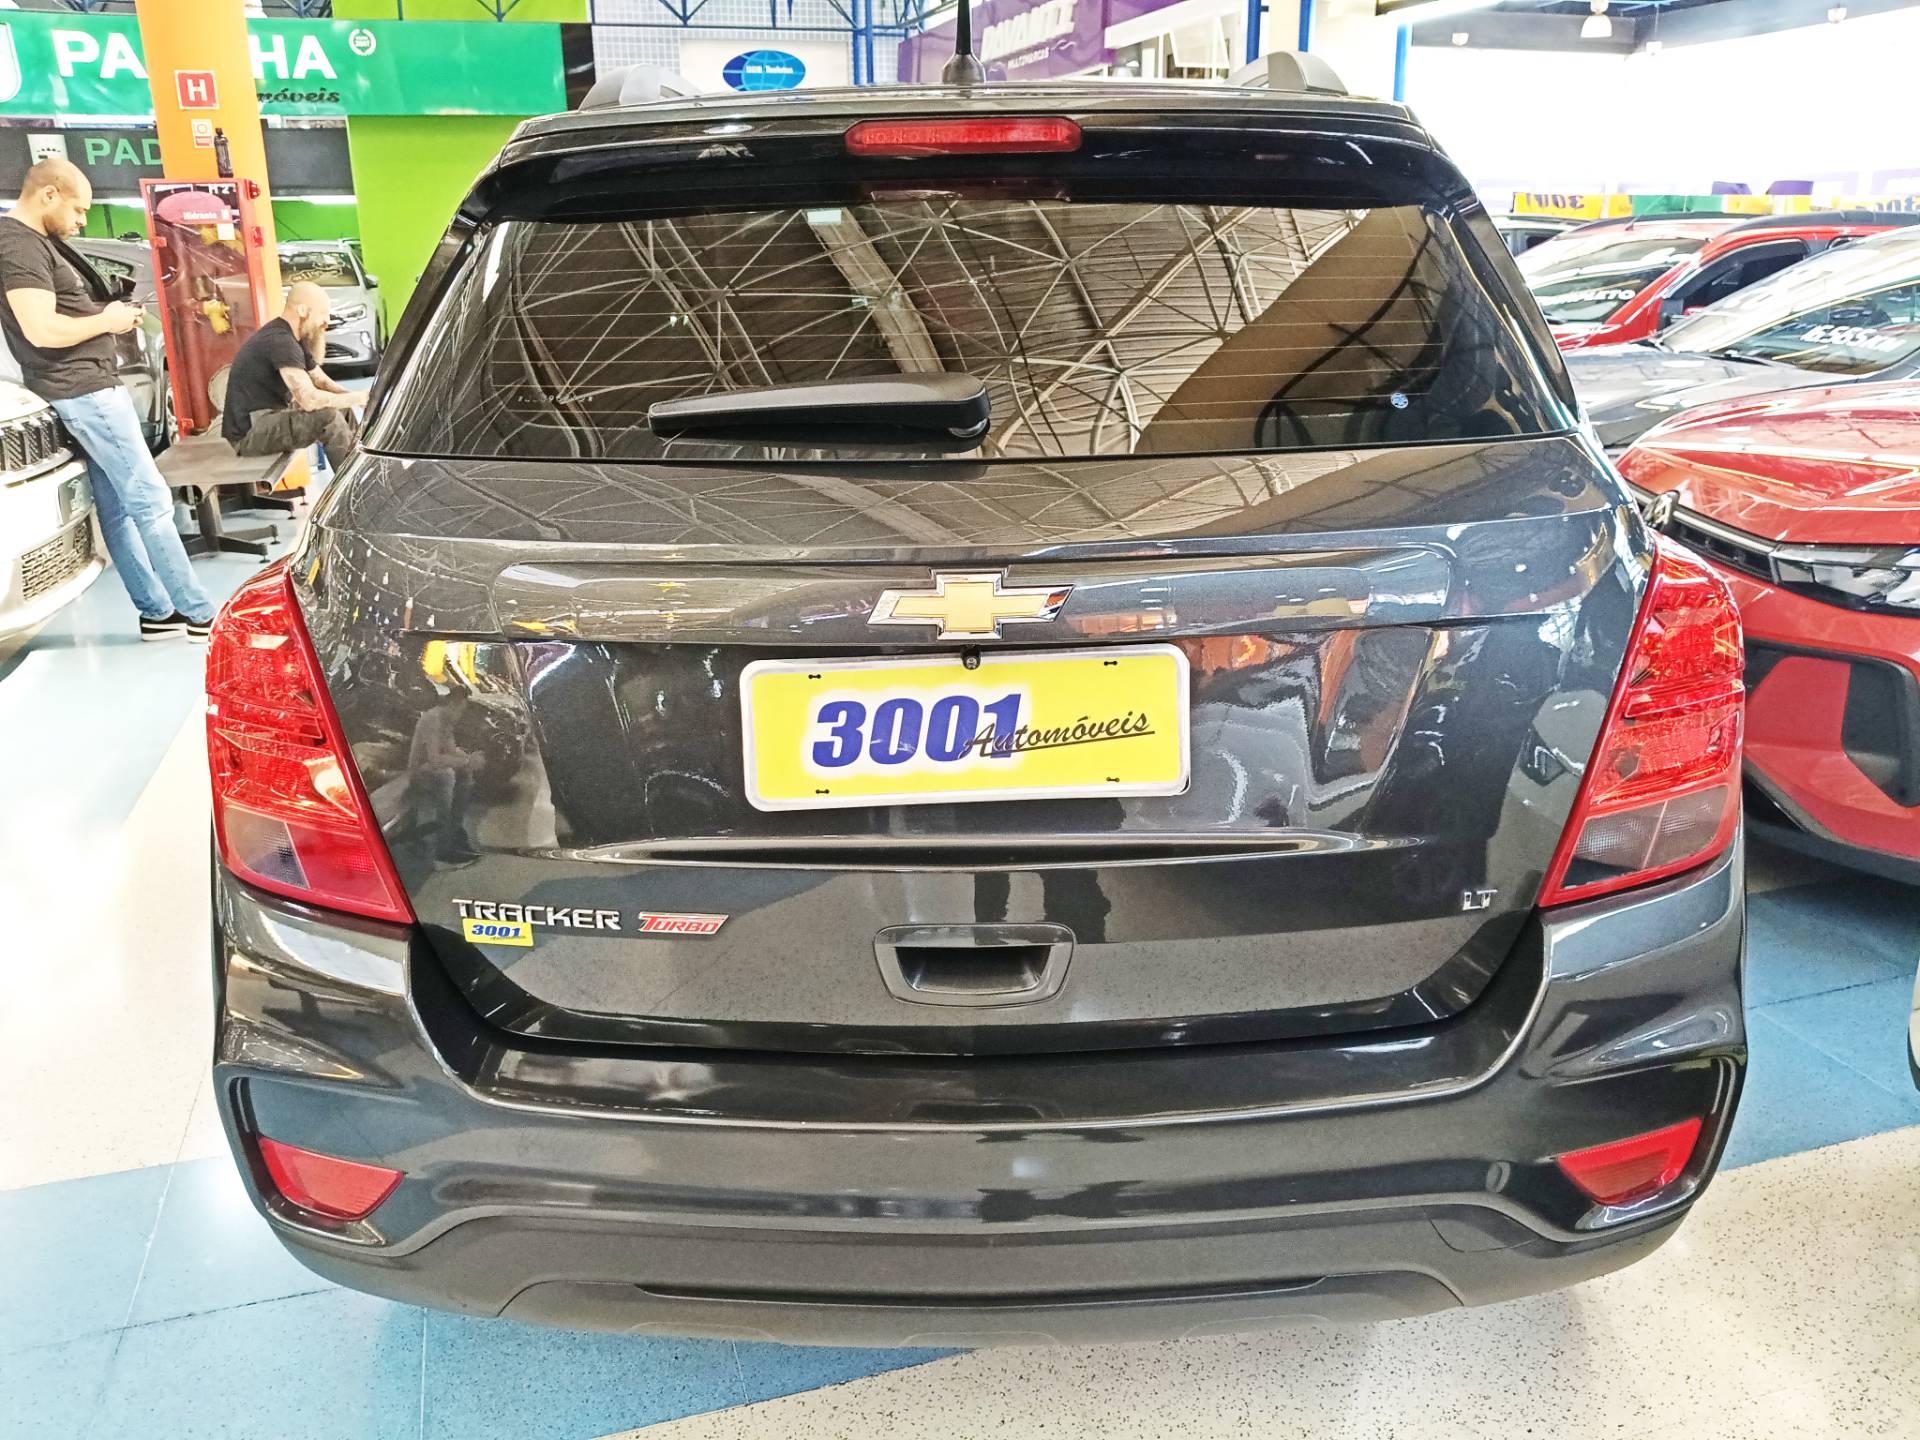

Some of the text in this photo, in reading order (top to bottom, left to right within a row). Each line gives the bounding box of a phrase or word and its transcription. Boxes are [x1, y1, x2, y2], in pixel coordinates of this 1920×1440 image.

[186, 78, 208, 102] H
[812, 693, 1154, 768] 3001 Automóveis
[1462, 889, 1498, 911] LT
[452, 898, 721, 933] TRACKER TURBO
[471, 924, 521, 938] 3001
